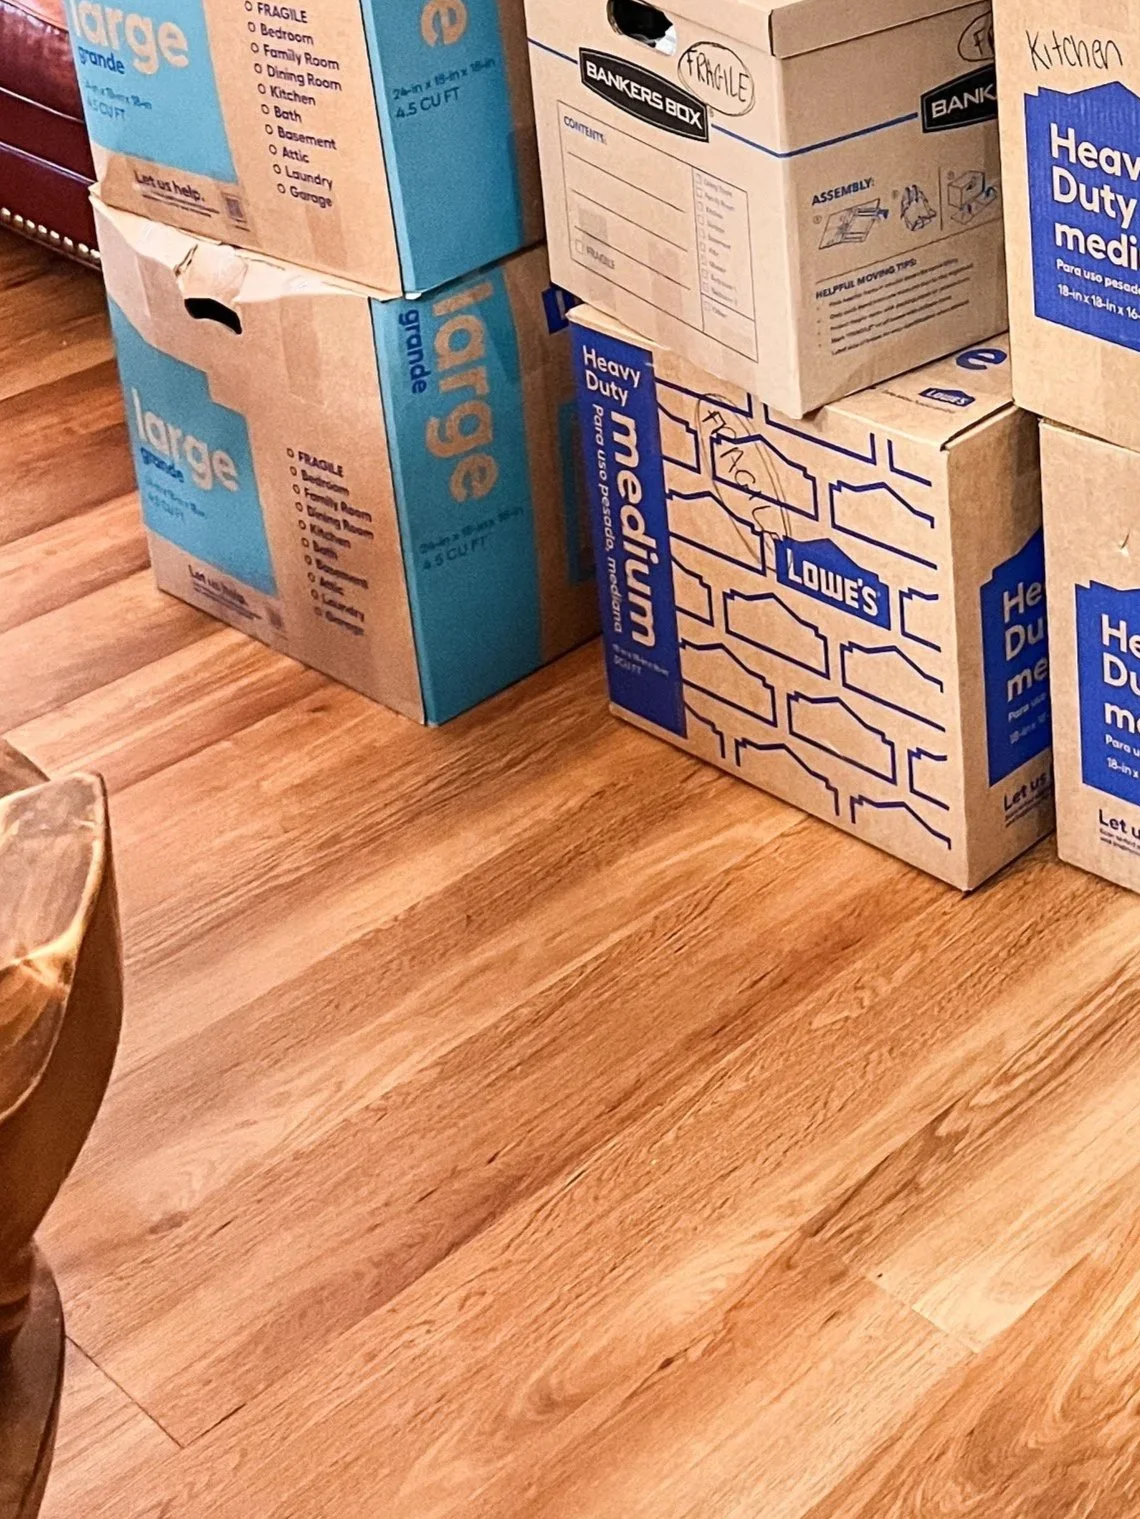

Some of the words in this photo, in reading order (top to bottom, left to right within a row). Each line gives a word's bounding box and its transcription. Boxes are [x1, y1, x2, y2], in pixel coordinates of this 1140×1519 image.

[258, 2, 308, 24] FRAGILE
[260, 23, 314, 45] Bedroom
[78, 46, 125, 75] grande
[264, 44, 302, 66] Family
[305, 52, 340, 70] Room
[1026, 30, 1124, 72] Kitchen
[267, 64, 305, 86] Dining
[307, 72, 342, 92] Room
[686, 50, 748, 102] FRAGILE
[270, 85, 316, 106] Kitchen
[394, 100, 418, 120] 4.5
[420, 92, 442, 112] CU
[444, 86, 460, 102] FT
[586, 60, 664, 110] BANKERS
[666, 96, 703, 130] BOX
[274, 106, 302, 124] Bath
[277, 126, 337, 150] Basement
[282, 146, 310, 164] Attic
[133, 169, 156, 188] Let
[156, 180, 172, 192] us
[172, 180, 205, 202] help.
[286, 165, 333, 190] Laundry
[290, 186, 332, 208] Garage
[1052, 166, 1138, 229] Duty
[816, 280, 855, 300] HELPFUL
[856, 266, 896, 286] MOVING
[1056, 258, 1081, 277] Para
[1082, 268, 1103, 284] uso
[399, 308, 431, 396] grande
[582, 345, 640, 388] Heavy
[425, 282, 498, 504] large
[586, 369, 628, 407] Duty
[131, 388, 238, 492] large
[592, 404, 604, 446] Para
[140, 446, 184, 484] grande
[298, 450, 344, 478] FRAGILE
[598, 449, 608, 480] uso
[598, 483, 616, 552] pesado,
[611, 410, 658, 647] medium
[608, 556, 622, 634] mediana
[786, 547, 878, 617] LOWE'S
[1106, 734, 1131, 754] Para
[1098, 808, 1128, 834] Let
